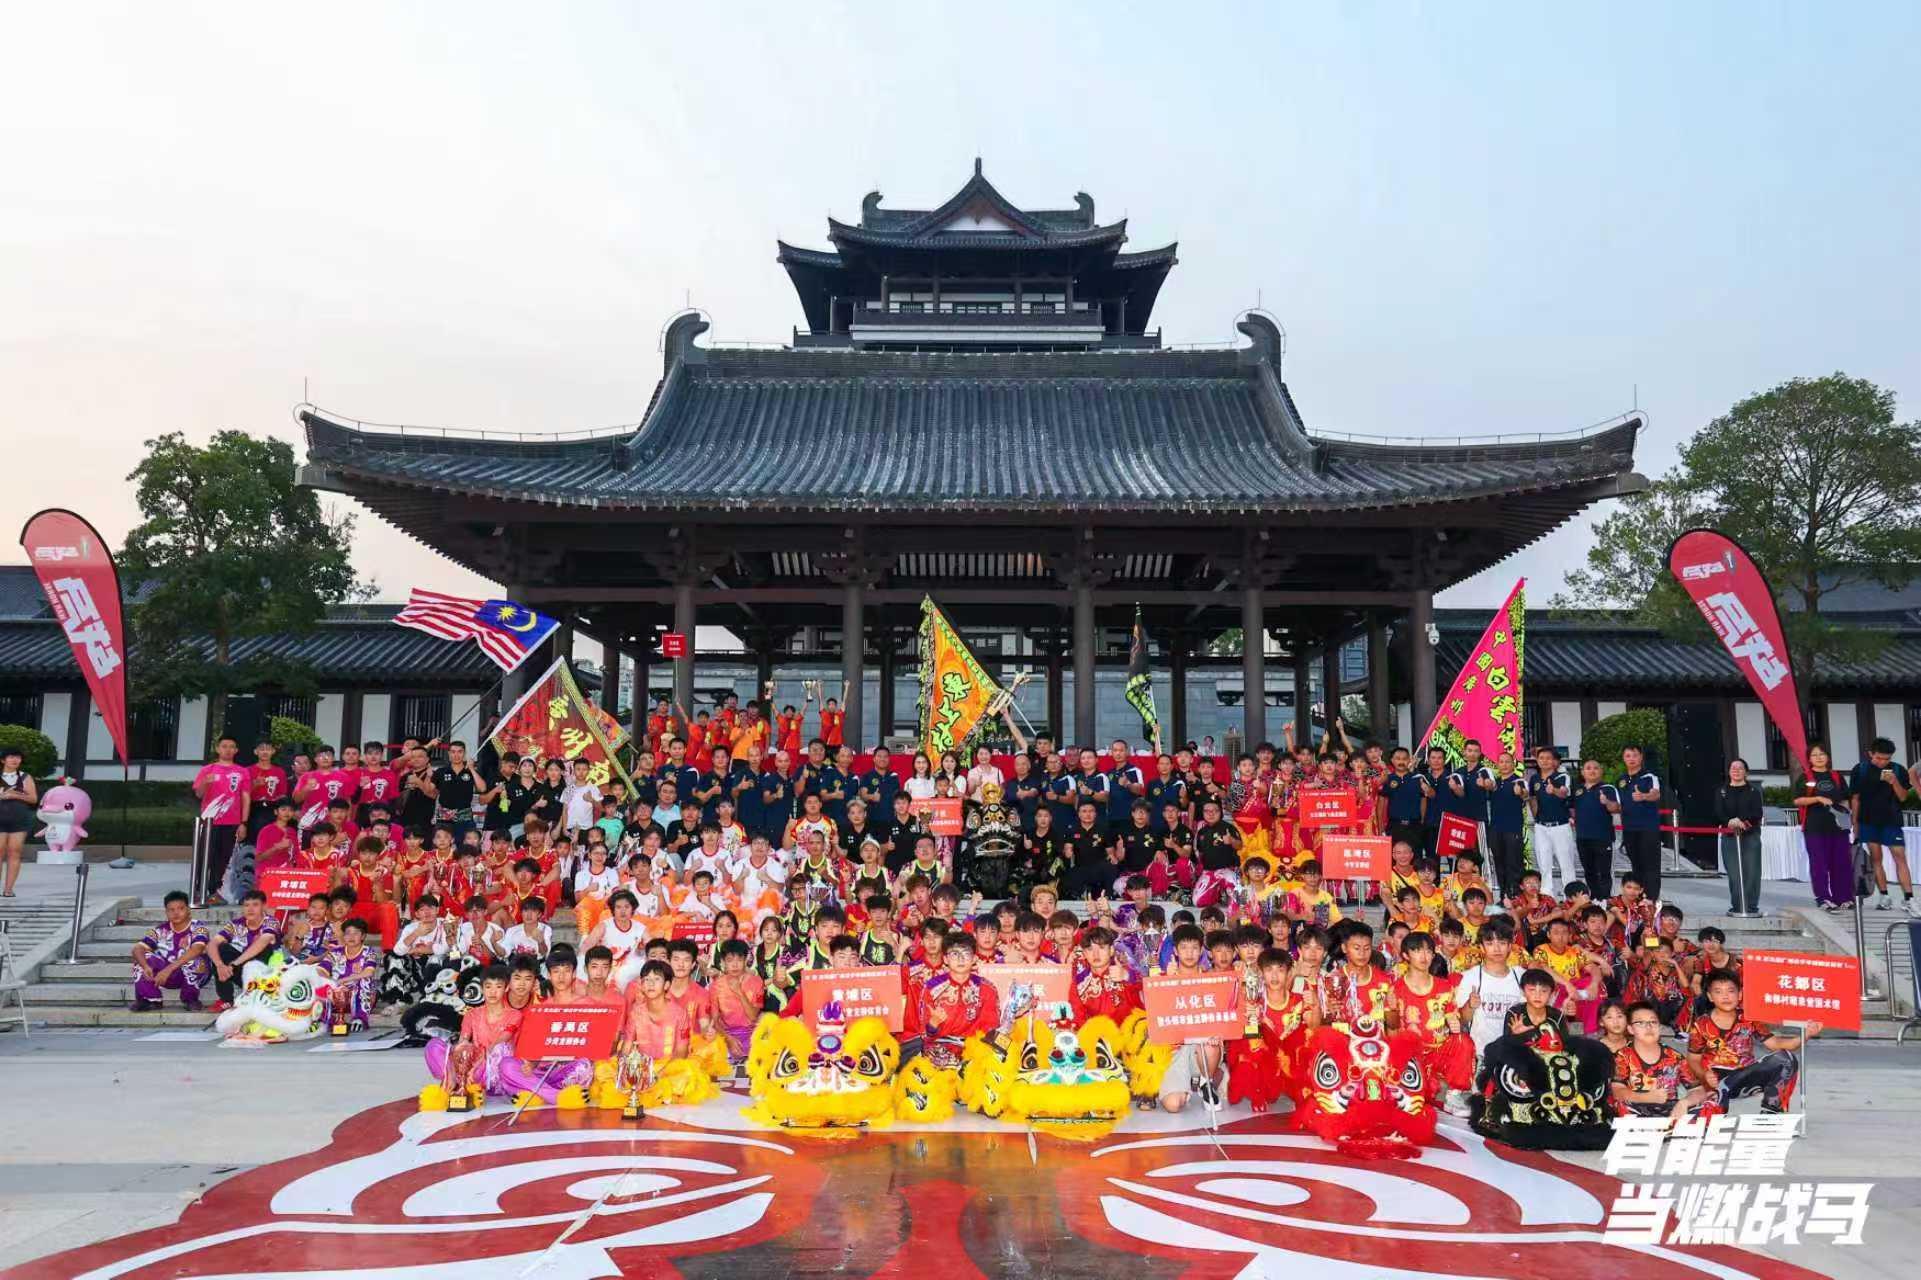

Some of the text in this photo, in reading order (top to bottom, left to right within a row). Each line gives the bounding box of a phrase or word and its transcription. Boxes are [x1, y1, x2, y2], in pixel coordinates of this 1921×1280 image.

[1778, 974, 1826, 992] 花都区
[1175, 994, 1216, 1009] 从化区
[550, 1021, 590, 1033] 番禺区
